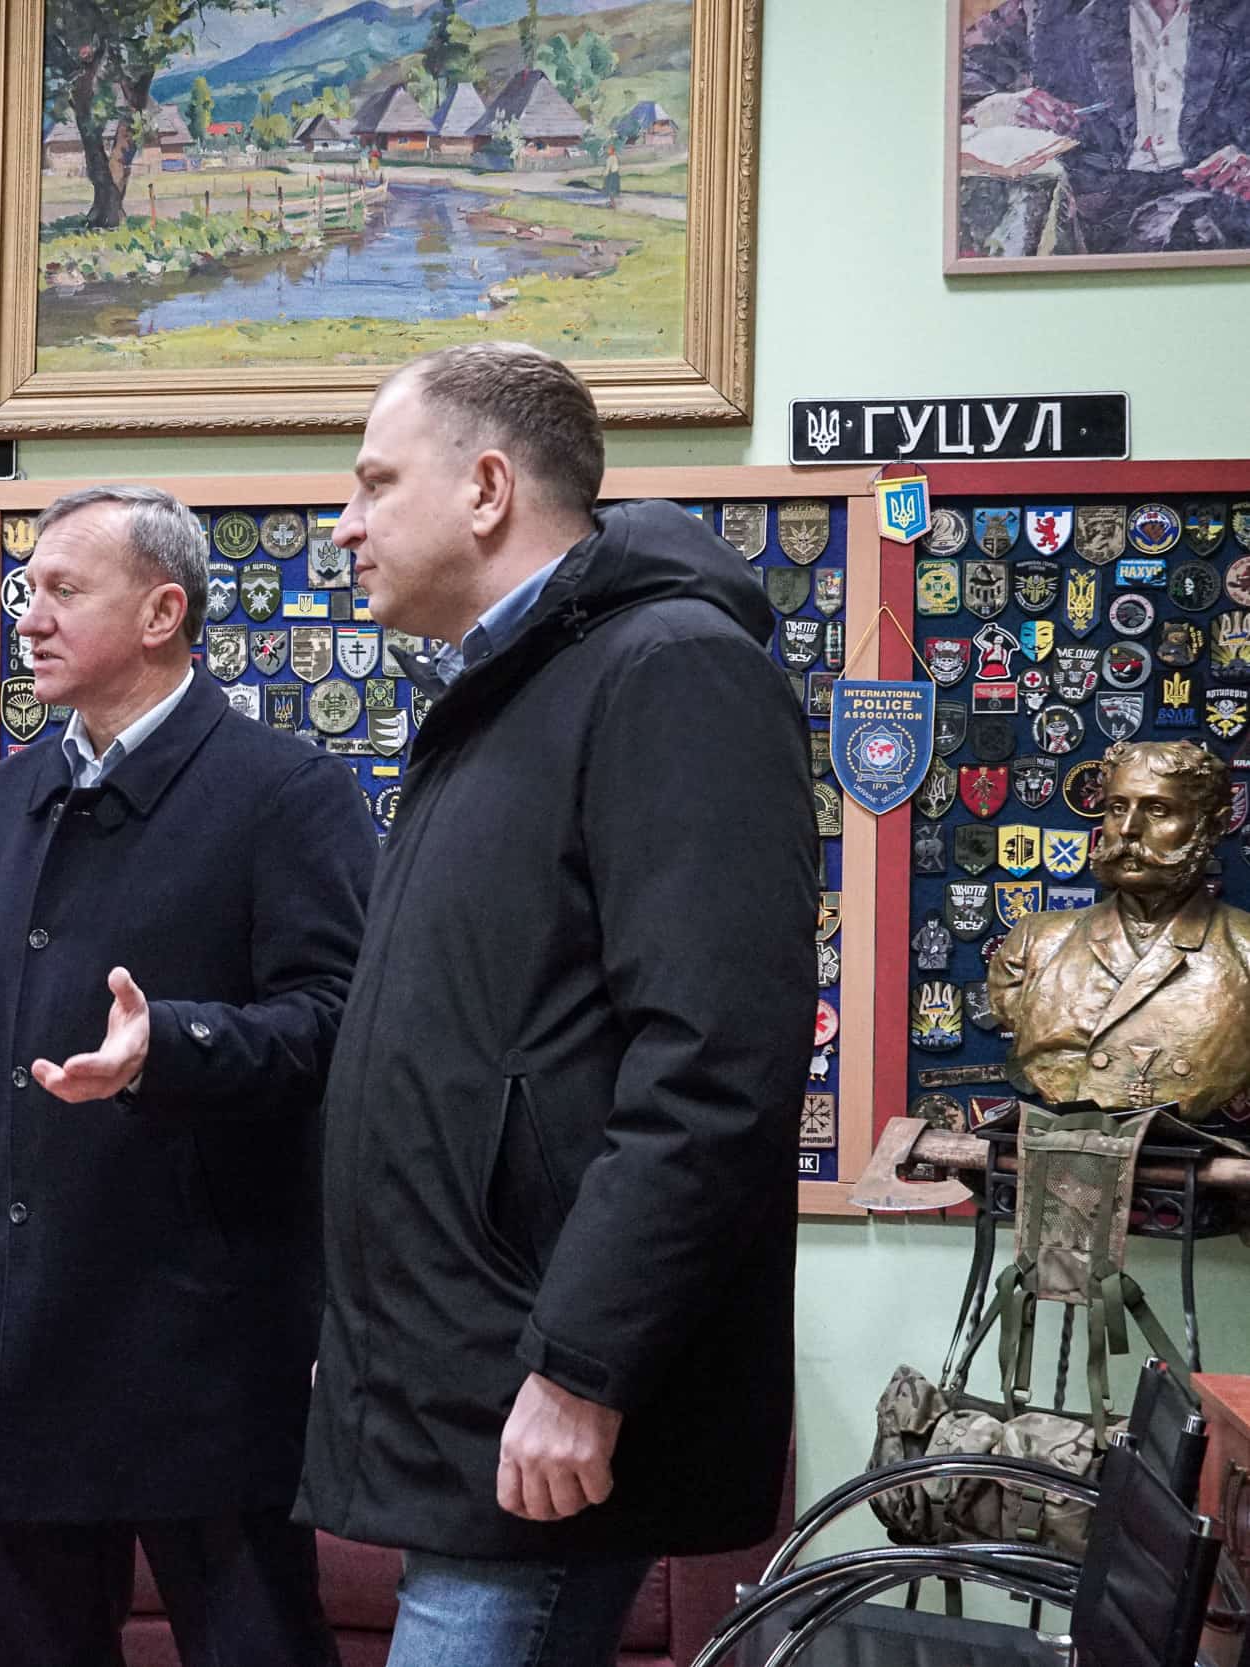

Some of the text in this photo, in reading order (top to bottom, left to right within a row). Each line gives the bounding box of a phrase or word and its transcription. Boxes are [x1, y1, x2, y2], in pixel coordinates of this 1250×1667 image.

[862, 402, 1062, 455] ГУЦУЛ
[7, 682, 35, 693] УКРО
[844, 689, 923, 699] INTERNATIONAL
[853, 699, 913, 711] POLICE
[844, 711, 923, 720] ASSOCIATION
[872, 783, 889, 791] IPA
